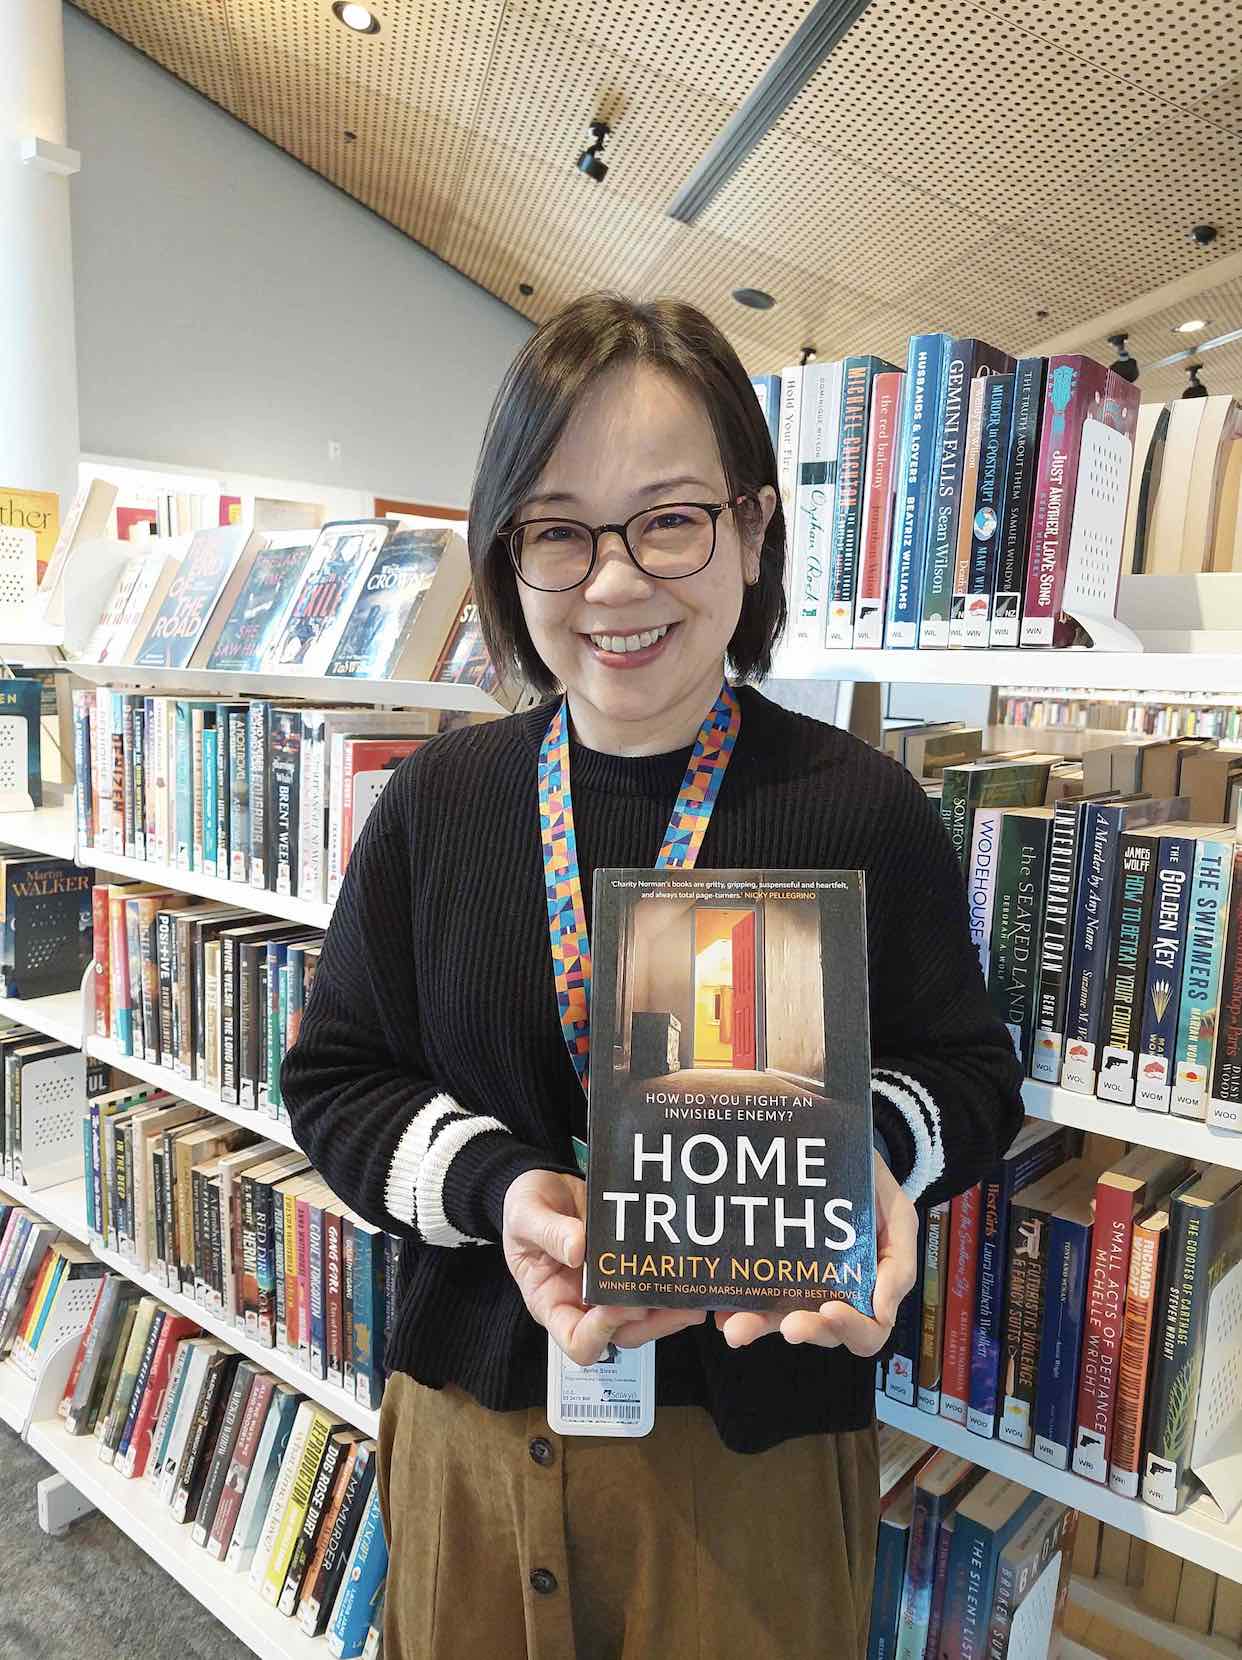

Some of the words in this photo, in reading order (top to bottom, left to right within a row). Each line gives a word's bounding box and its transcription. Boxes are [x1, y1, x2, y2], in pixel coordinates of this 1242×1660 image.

[786, 378, 796, 408] Hold
[845, 367, 867, 432] MICHAEL
[914, 352, 928, 420] HUSBANDS
[944, 360, 964, 433] GEMINI
[1022, 372, 1032, 393] THE
[880, 395, 894, 415] the
[986, 384, 1004, 430] MURDER
[1018, 395, 1030, 430] TRUTH
[784, 414, 794, 442] Your
[878, 419, 888, 438] red
[912, 424, 922, 432] &
[989, 429, 1000, 438] in
[872, 443, 889, 488] balcony
[909, 436, 920, 483] LOVERS
[1015, 432, 1026, 467] ABOUT
[939, 440, 959, 497] FALLS
[982, 440, 1000, 504] POSTSCRIPT
[1011, 469, 1022, 500] THEM
[1047, 450, 1068, 486] JUST
[0, 498, 51, 530] ther
[800, 489, 827, 549] Orphan
[903, 496, 916, 546] BEATRIZ
[937, 506, 952, 542] Sean
[1008, 508, 1019, 546] SAMUEL
[1044, 488, 1064, 538] ANOTHER
[932, 542, 949, 594] Wilson
[975, 546, 988, 573] MARY
[1040, 540, 1060, 572] LOVE
[898, 550, 912, 610] WILLIAMS
[1038, 573, 1055, 607] SONG
[152, 617, 203, 638] ROAD
[1005, 610, 1016, 618] NZ
[966, 630, 982, 638] WIN
[278, 786, 290, 828] BRENT
[1096, 813, 1110, 826] A
[1019, 846, 1037, 877] the
[1046, 809, 1076, 925] INTERLIBRARY
[1092, 828, 1110, 876] Murder
[1123, 859, 1150, 872] WOLFF
[1124, 847, 1150, 860] JAMES
[1169, 846, 1180, 864] THE
[12, 876, 89, 898] WALKER
[638, 880, 671, 888] Norman's
[706, 881, 726, 890] gritty,
[727, 881, 758, 890] gripping,
[759, 881, 801, 890] suspenseful
[816, 882, 849, 890] heartfelt,
[969, 820, 994, 938] WODEHOUSE
[1088, 874, 1104, 888] by
[1124, 874, 1145, 905] HOW
[1199, 856, 1222, 891] THE
[656, 892, 678, 900] always
[744, 892, 768, 900] NICKY
[769, 892, 817, 900] PELLEGRINO
[1084, 889, 1102, 912] Any
[1159, 869, 1186, 932] GOLDEN
[1000, 896, 1010, 940] DEBORAH
[1008, 882, 1034, 962] SEARED
[1084, 914, 1100, 951] Name
[1122, 908, 1142, 923] TO
[224, 939, 233, 972] IRVINE
[1042, 932, 1066, 973] LOAN
[1116, 924, 1140, 971] BETRAY
[1152, 936, 1181, 969] KEY
[1188, 898, 1218, 1002] SWIMMERS
[224, 974, 234, 1008] WELSH
[1008, 968, 1029, 1023] LAND
[1042, 994, 1056, 1017] GENE
[1079, 969, 1093, 1010] Suzanne
[1114, 974, 1136, 1004] YOUR
[224, 1016, 234, 1037] THE
[1188, 1008, 1200, 1042] MARIAN
[224, 1038, 234, 1062] LONG
[1140, 1091, 1164, 1102] WOM
[1220, 1062, 1232, 1100] WOOD
[1230, 1064, 1242, 1100] DAISY
[646, 1093, 680, 1105] HOW
[685, 1094, 706, 1106] DO
[712, 1095, 741, 1106] YOU
[746, 1096, 788, 1107] FIGHT
[792, 1096, 814, 1108] AN
[664, 1108, 732, 1120] INVISIBLE
[737, 1110, 793, 1122] ENEMY?
[1176, 1094, 1200, 1107] WOM
[116, 1140, 124, 1151] IN
[116, 1154, 125, 1170] THE
[633, 1133, 827, 1188] HOME
[117, 1175, 126, 1200] DEEP
[256, 1212, 267, 1245] RED
[602, 1192, 857, 1250] TRUTHS
[1190, 1220, 1200, 1238] THE
[242, 1230, 257, 1276] HERMIT
[310, 1224, 321, 1256] GONE
[328, 1226, 338, 1260] GANG
[927, 1223, 940, 1270] WOODSON
[982, 1240, 996, 1268] Laura
[1111, 1220, 1126, 1271] SMALL
[256, 1246, 267, 1278] DIRT
[598, 1252, 721, 1280] CHARITY
[731, 1258, 862, 1285] NORMAN
[1140, 1239, 1155, 1300] RICHARD
[1186, 1238, 1199, 1282] COYOTES
[328, 1263, 339, 1294] GIRL
[598, 1281, 636, 1292] WINNER
[638, 1282, 652, 1292] OF
[654, 1283, 673, 1293] THE
[674, 1284, 708, 1294] NGAIO
[708, 1285, 744, 1296] MARSH
[744, 1286, 781, 1297] AWARD
[782, 1288, 804, 1298] FOR
[804, 1288, 828, 1299] BEST
[979, 1269, 995, 1318] Elizabeth
[1010, 1269, 1026, 1309] FANCY
[1090, 1248, 1108, 1328] MICHELLE
[1184, 1284, 1194, 1297] OF
[1023, 1262, 1042, 1330] FUTURISTIC
[1104, 1278, 1120, 1319] ACTS
[1168, 1286, 1180, 1323] STEVEN
[1008, 1309, 1024, 1346] SUITS
[1102, 1326, 1116, 1350] OF
[1176, 1298, 1192, 1346] CARTHAGE
[1018, 1330, 1040, 1387] VIOLENCE
[1165, 1324, 1178, 1362] WRIGHT
[1084, 1335, 1100, 1396] WRIGHT
[1094, 1355, 1113, 1433] DEFIANCE
[1005, 1426, 1024, 1439] WON
[292, 1420, 328, 1508] REPRODUCTION
[326, 1444, 339, 1474] DOG
[313, 1475, 330, 1508] ROSE
[347, 1478, 360, 1504] MY
[303, 1508, 320, 1540] DIRT
[324, 1505, 351, 1572] MURDER
[969, 1538, 984, 1568] THE
[966, 1570, 982, 1625] SILENT
[996, 1567, 1015, 1625] BROKEN
[960, 1628, 975, 1660] LIST
